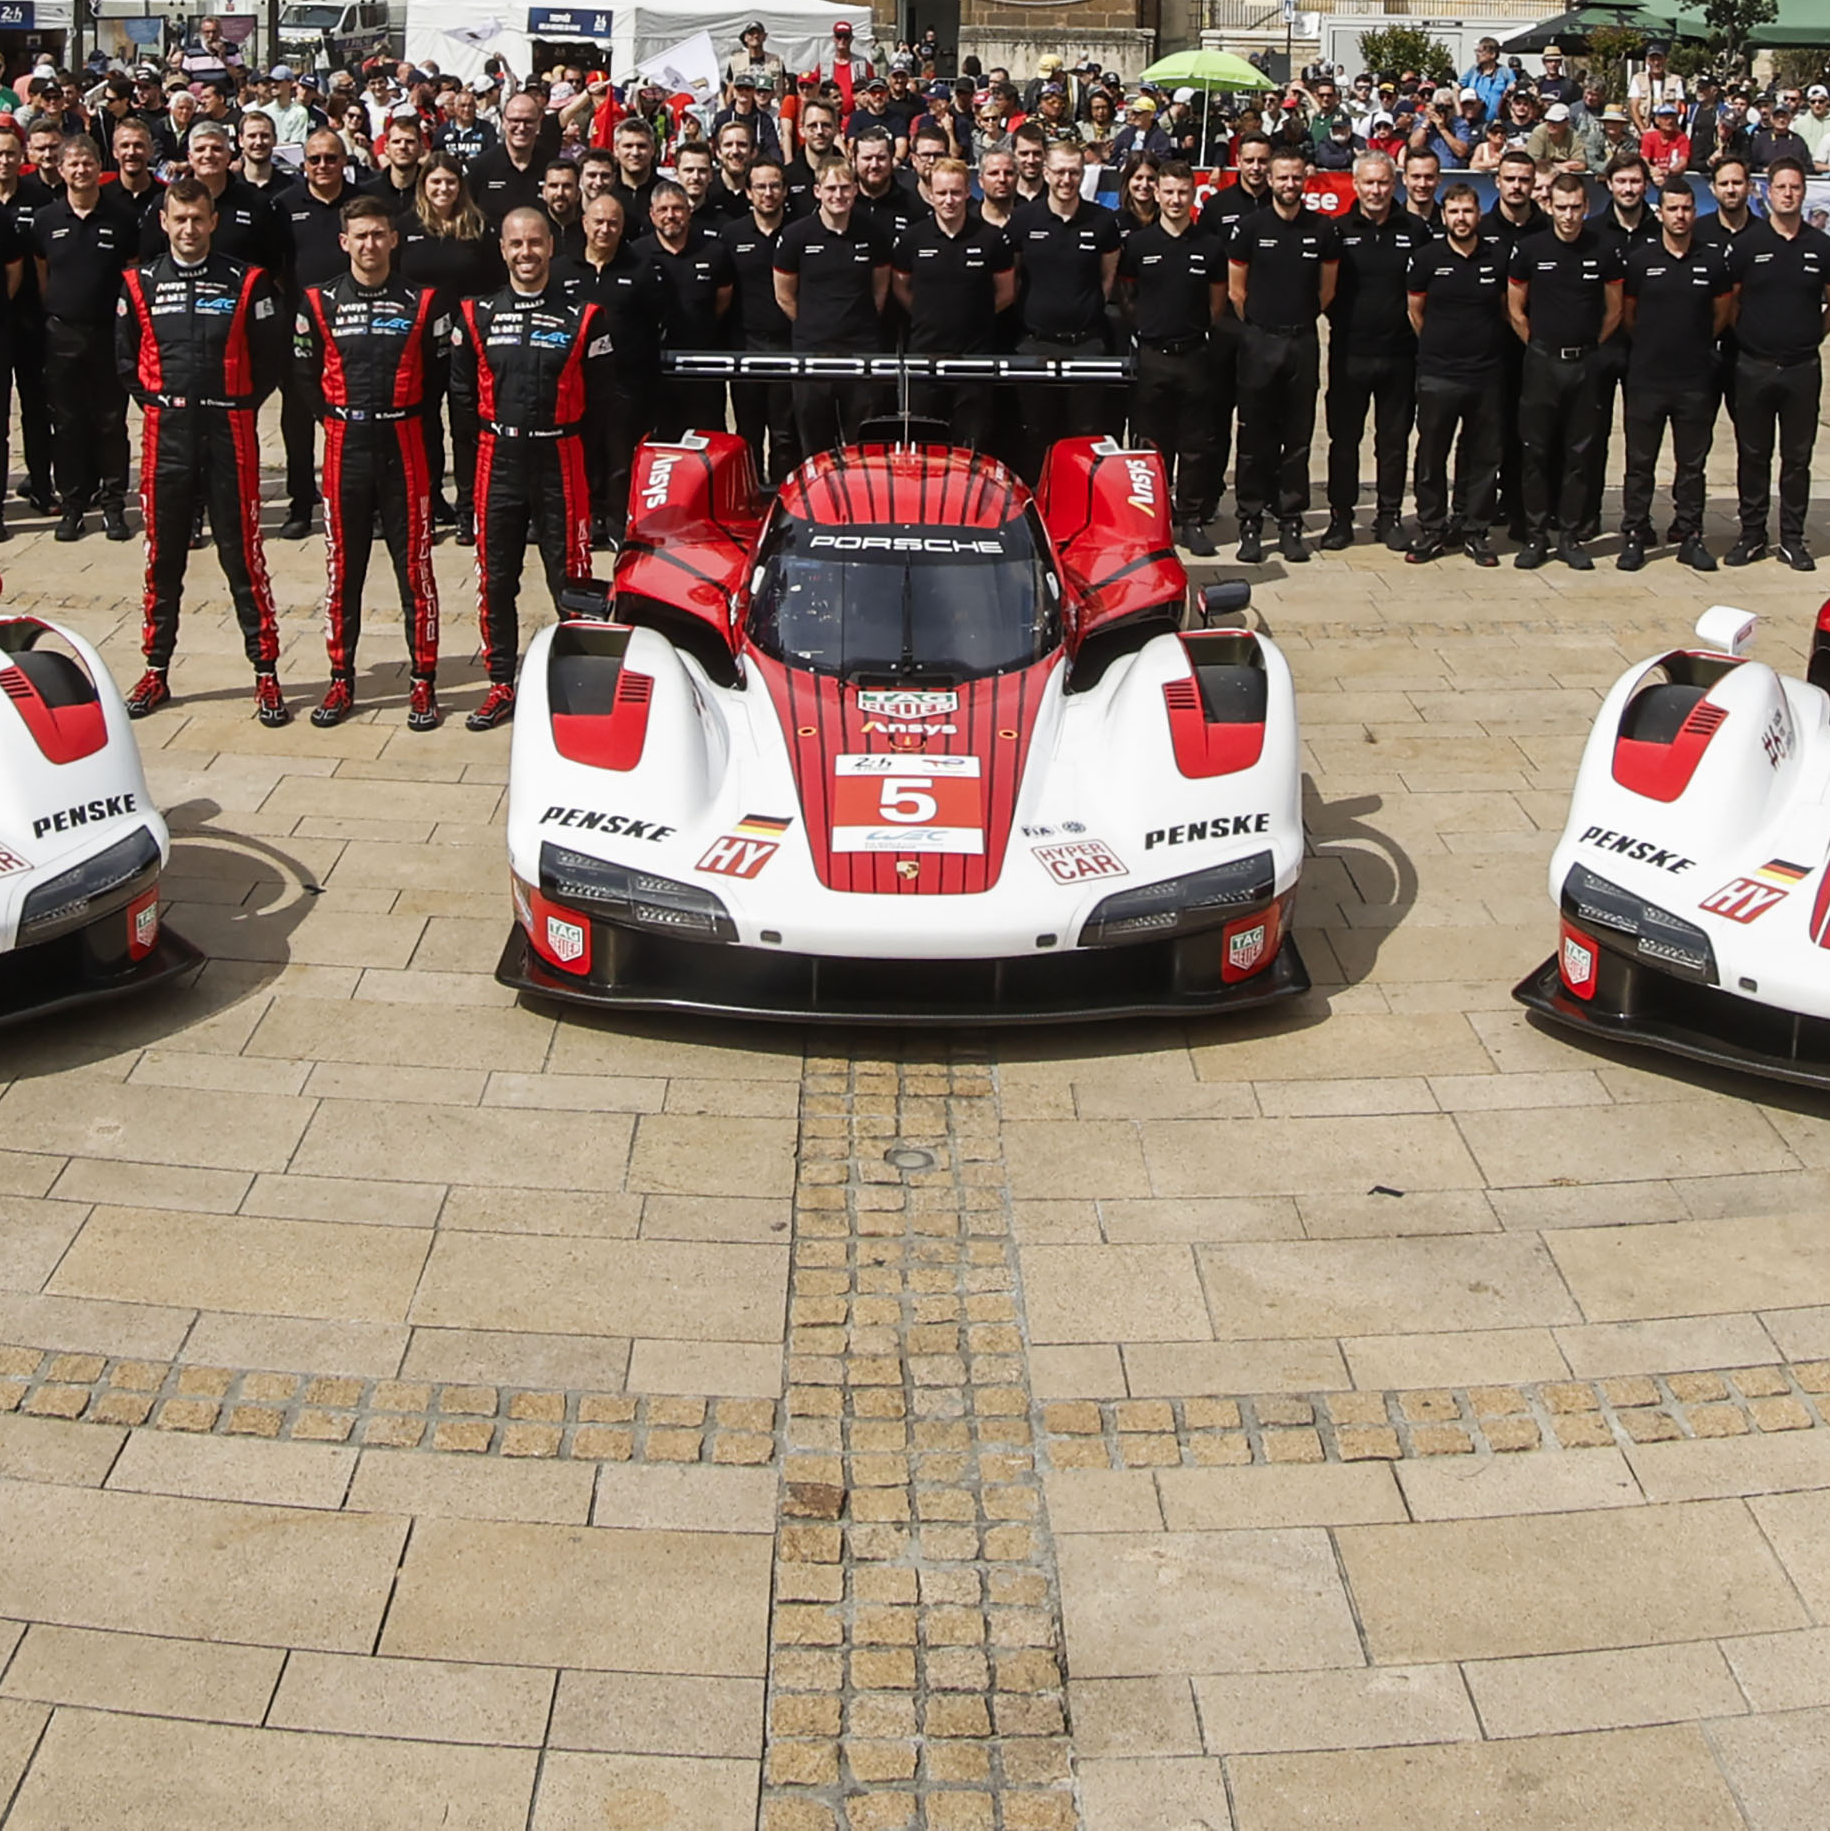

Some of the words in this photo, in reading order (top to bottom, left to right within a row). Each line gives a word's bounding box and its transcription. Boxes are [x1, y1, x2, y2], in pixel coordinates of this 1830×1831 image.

[156, 282, 186, 292] Ansys
[337, 303, 367, 313] Ansys
[493, 314, 523, 322] Ansys
[645, 452, 682, 510] Ansys
[1127, 458, 1157, 516] Ansys
[810, 535, 1003, 556] PORSCHE
[863, 691, 953, 702] TAG
[862, 702, 953, 716] HEUER
[861, 721, 957, 735] Ansys
[879, 778, 937, 823] 5
[33, 794, 137, 839] PENSKE
[539, 806, 677, 843] PENSKE
[1145, 813, 1270, 850] PENSKE
[699, 840, 770, 874] HY
[1040, 842, 1104, 861] HYPER
[1578, 826, 1697, 875] PENSKE
[1050, 855, 1120, 880] CAR
[1704, 880, 1781, 920] HY
[549, 917, 580, 941] TAG
[1232, 927, 1263, 950] TAG
